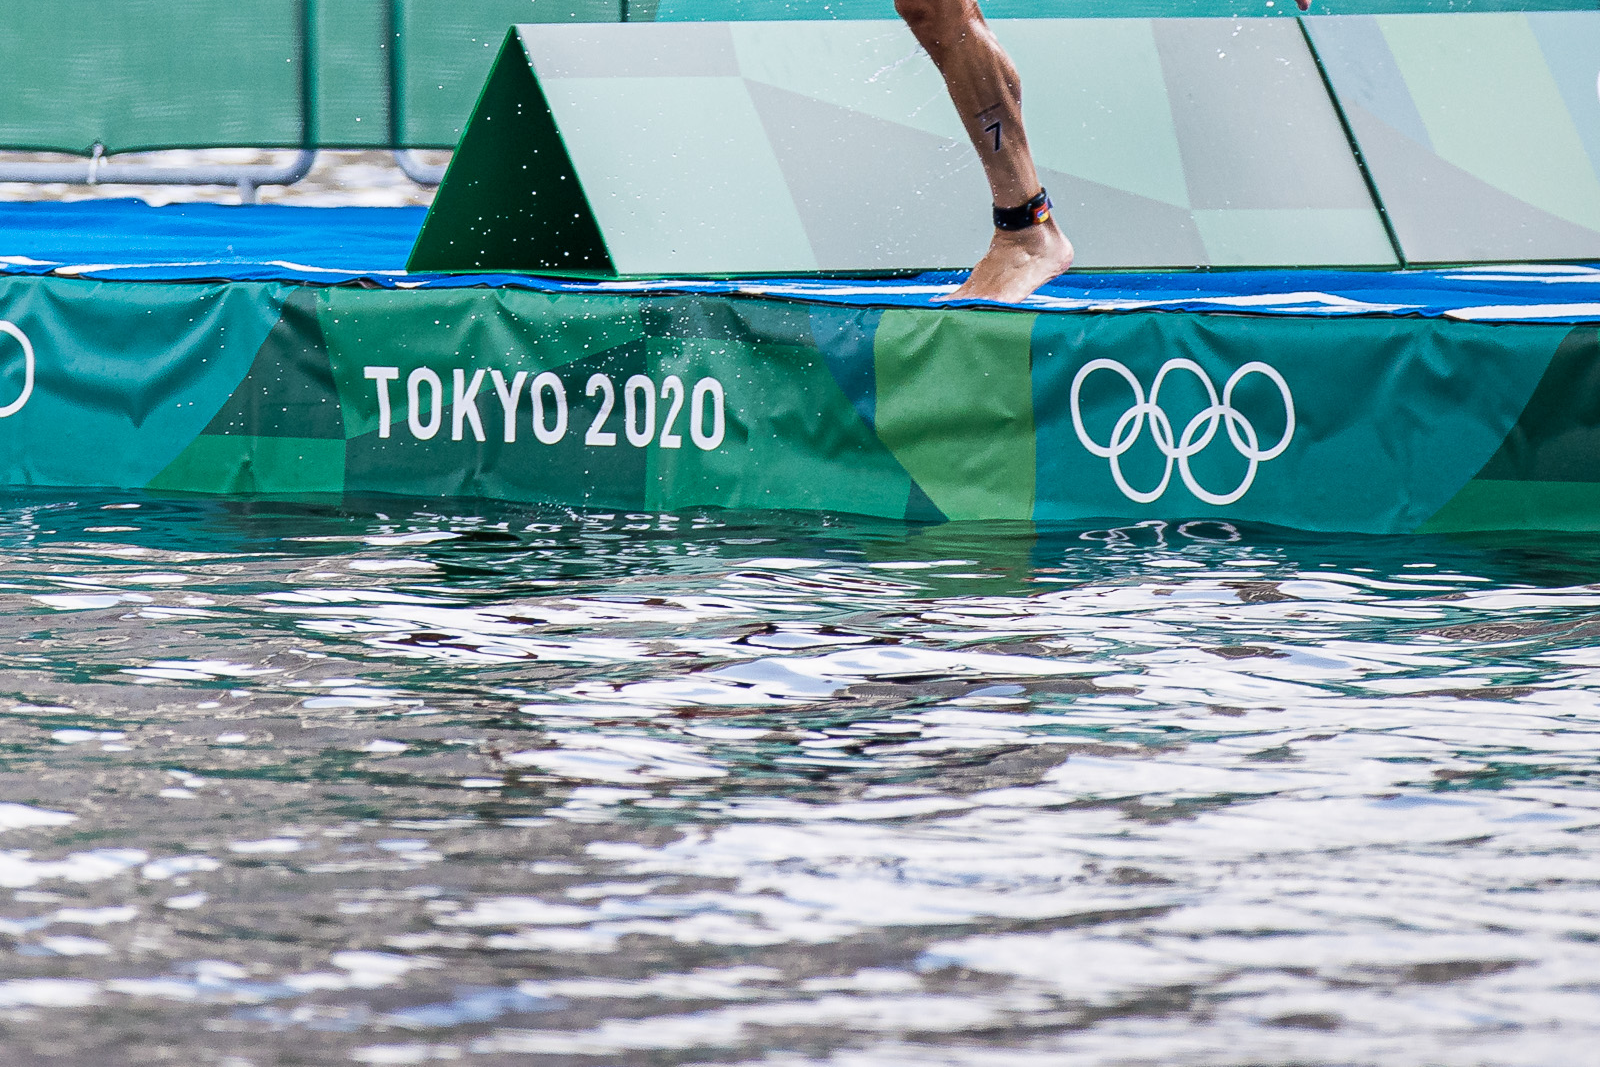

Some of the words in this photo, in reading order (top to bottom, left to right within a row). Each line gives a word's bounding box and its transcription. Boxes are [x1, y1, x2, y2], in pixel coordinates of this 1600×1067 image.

[984, 120, 1003, 153] 7
[363, 365, 569, 445] TOKYO
[584, 372, 726, 451] 2020
